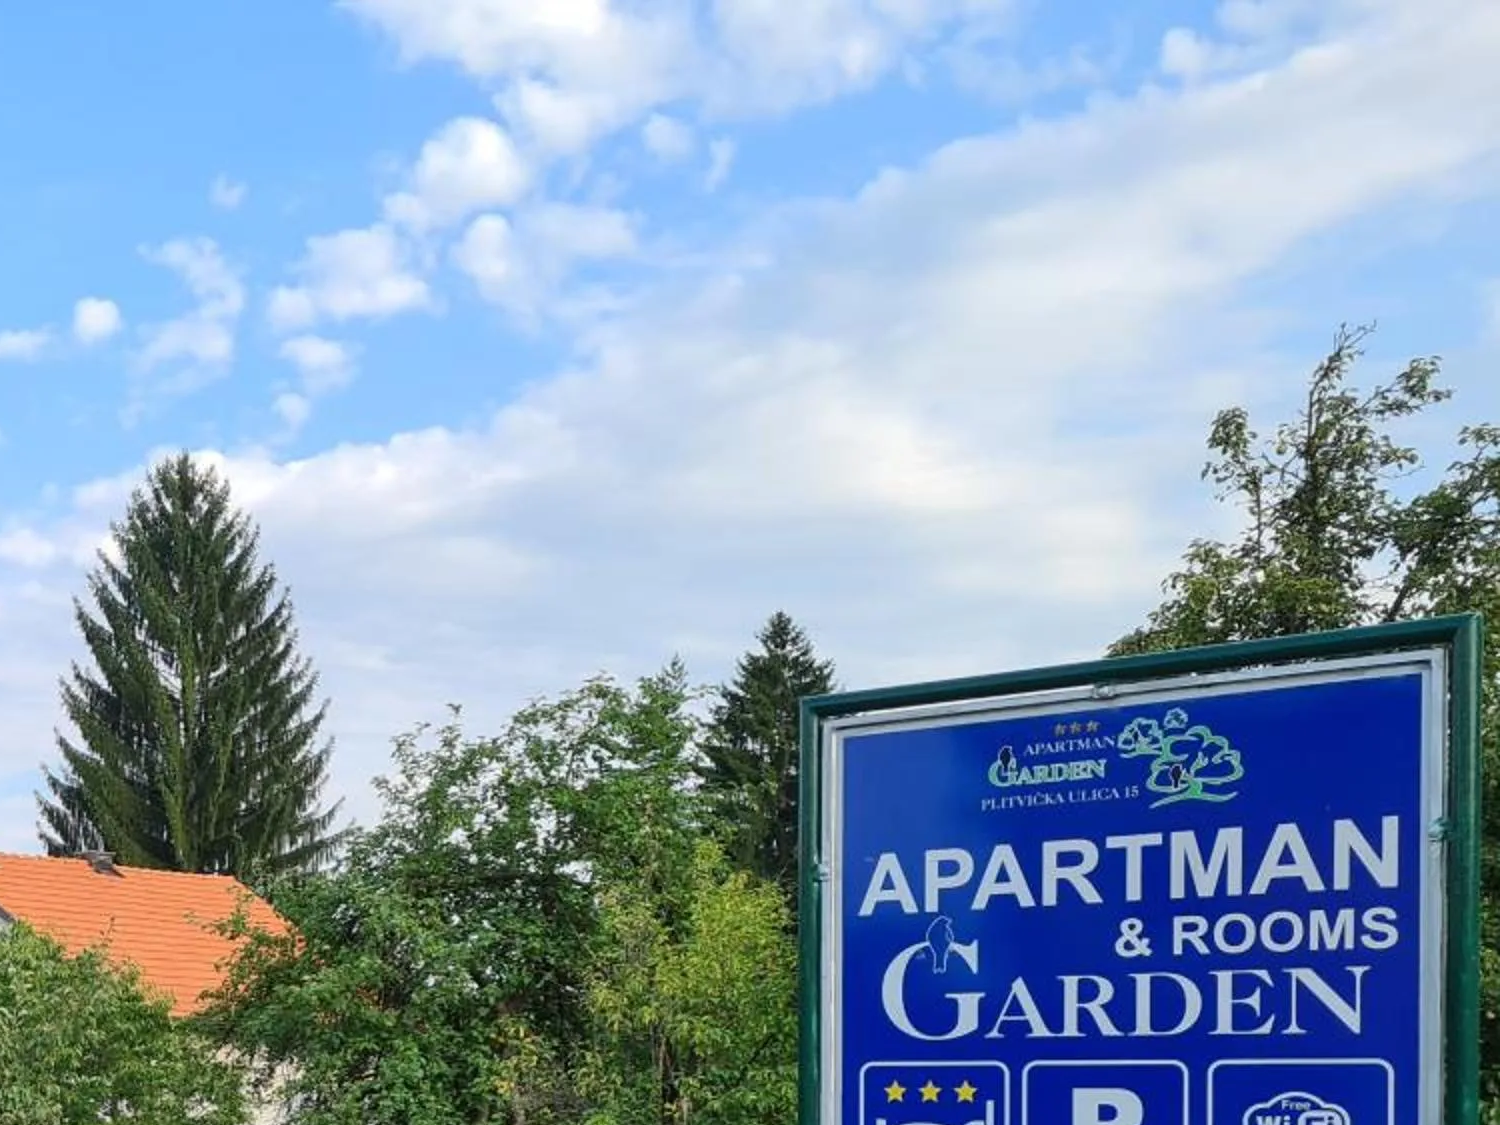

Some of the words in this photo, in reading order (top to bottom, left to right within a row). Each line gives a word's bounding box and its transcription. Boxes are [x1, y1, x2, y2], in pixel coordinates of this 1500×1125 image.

[988, 757, 1107, 787] GARDEN
[1068, 788, 1120, 803] ULICA
[1125, 786, 1139, 798] 15
[858, 815, 1401, 916] APARTMAN
[1115, 917, 1151, 958] &
[1173, 906, 1399, 956] ROOMS
[881, 938, 1371, 1041] GARDEN
[1281, 1099, 1312, 1110] Free
